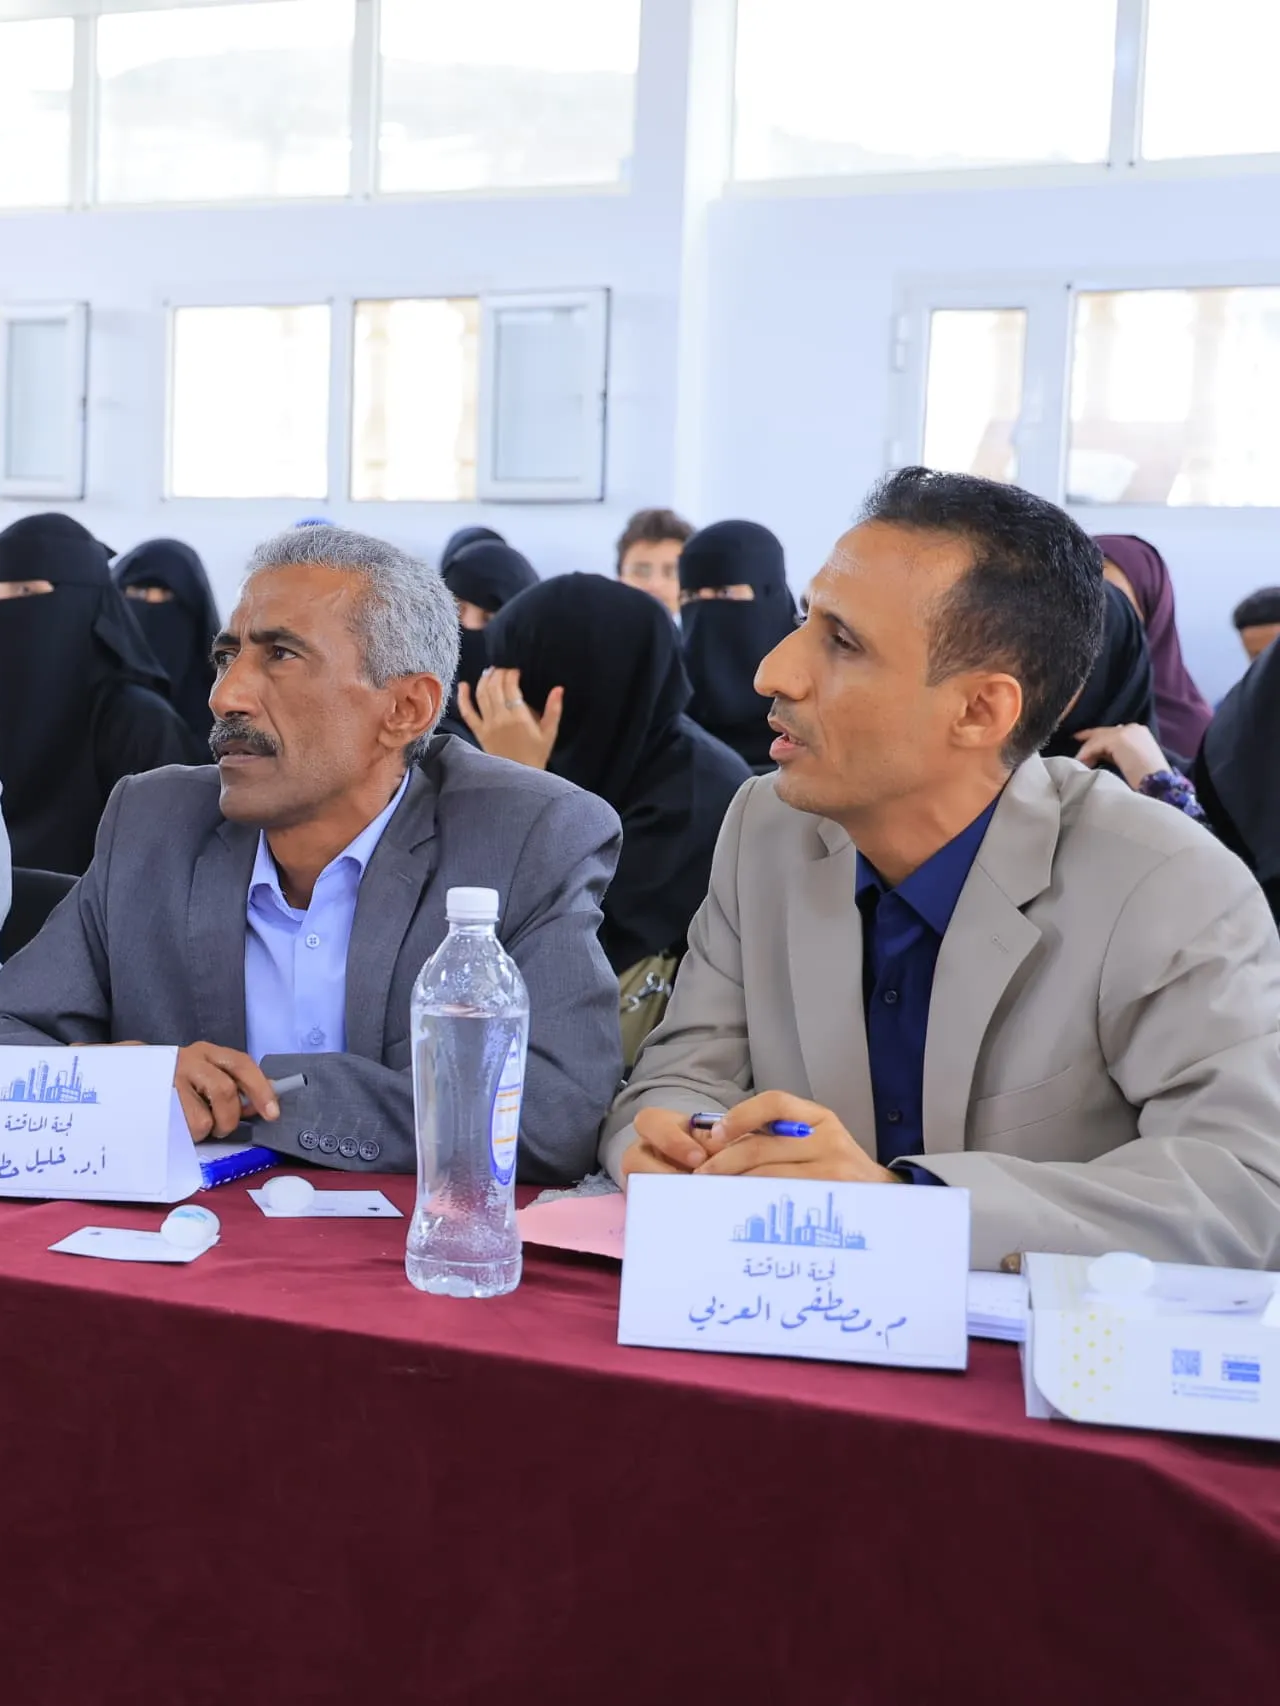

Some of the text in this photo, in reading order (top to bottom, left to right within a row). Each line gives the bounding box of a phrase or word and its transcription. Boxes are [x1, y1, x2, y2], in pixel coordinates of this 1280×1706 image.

[4, 1112, 73, 1137] لجنة المناقشة
[25, 1146, 67, 1174] خليل
[743, 1257, 836, 1286] لجنة المناقشة
[780, 1286, 872, 1333] مصطفى
